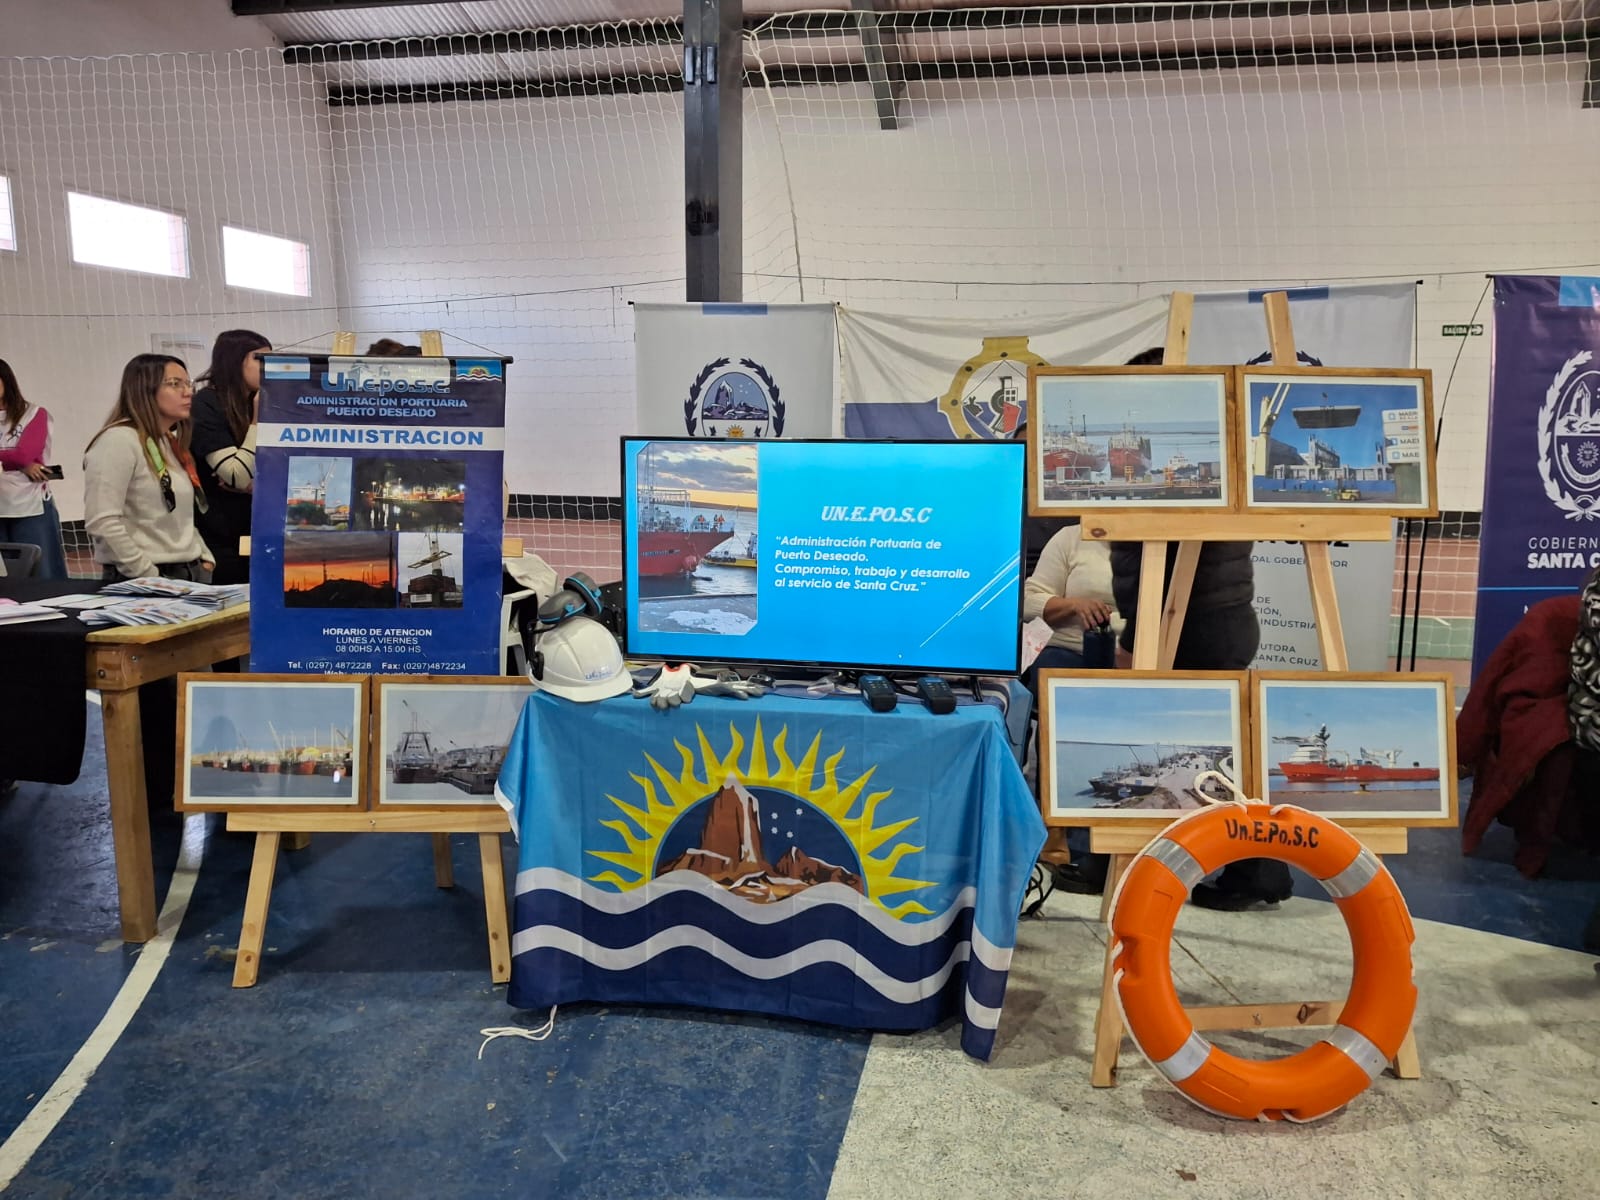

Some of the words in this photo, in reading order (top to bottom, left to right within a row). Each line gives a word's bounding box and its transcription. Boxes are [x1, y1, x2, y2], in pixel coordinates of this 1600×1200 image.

[297, 396, 398, 407] ADMINISTRACION
[400, 398, 468, 408] PORTUARIA
[326, 407, 376, 417] PUERTO
[378, 408, 436, 418] DESEADO
[279, 427, 484, 446] ADMINISTRACION
[869, 537, 922, 549] Portuaria
[925, 539, 942, 549] de
[775, 549, 811, 561] Puerto
[814, 551, 869, 563] Deseado.
[1527, 552, 1586, 569] SANTA
[775, 563, 851, 577] Compromiso,
[854, 566, 897, 578] trabajo
[900, 569, 908, 579] y
[911, 568, 971, 579] desarrollo
[774, 577, 785, 588] al
[788, 578, 832, 589] servicio
[835, 580, 851, 590] de
[854, 580, 887, 591] Santa
[1257, 596, 1271, 604] DE
[323, 628, 367, 636] HORARIO
[384, 629, 432, 637] ATENCION
[336, 637, 368, 645] LUNES
[378, 637, 418, 645] VIERNES
[408, 646, 422, 654] HS
[305, 661, 333, 670] (0297)
[335, 661, 372, 669] 4872228
[1289, 656, 1319, 667] CRUZ
